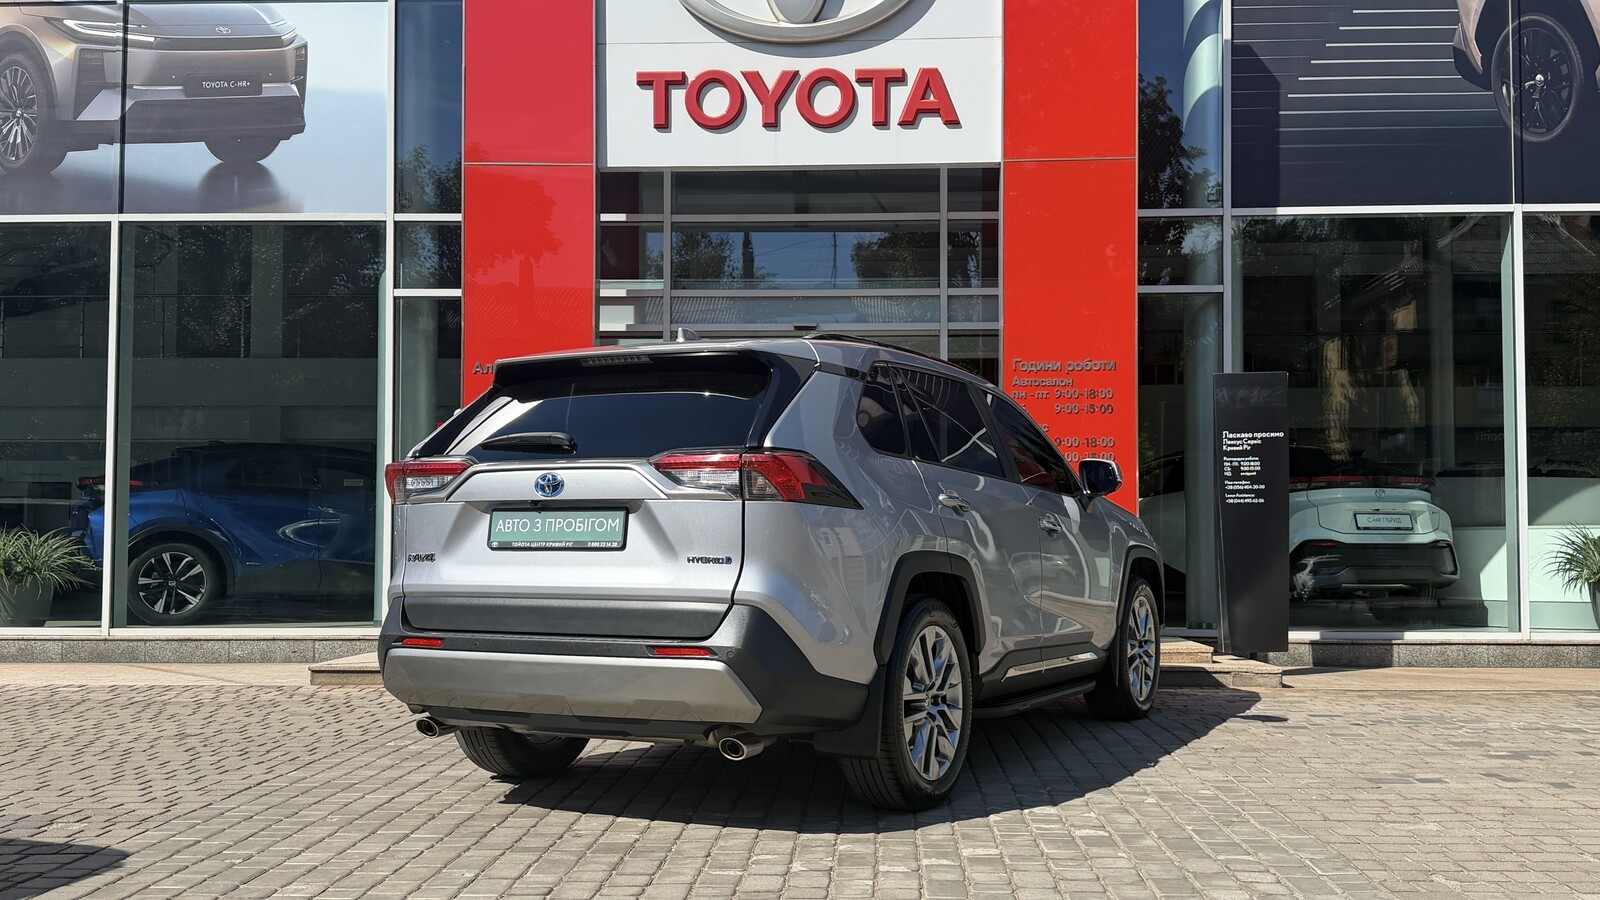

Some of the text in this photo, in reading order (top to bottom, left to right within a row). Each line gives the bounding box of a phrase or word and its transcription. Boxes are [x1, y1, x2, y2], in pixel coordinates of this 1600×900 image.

[636, 67, 961, 129] TOYOTA
[1013, 358, 1116, 374] Години роботи
[1012, 377, 1073, 387] Автосалон
[1055, 388, 1114, 399] 9:00-18:00
[1055, 404, 1114, 414] 9:00-15:00
[1054, 437, 1115, 448] 9:00-18:00
[496, 519, 530, 532] АВТО
[545, 518, 619, 532] ПРОБІГОМ
[687, 556, 724, 564] HYBRID
